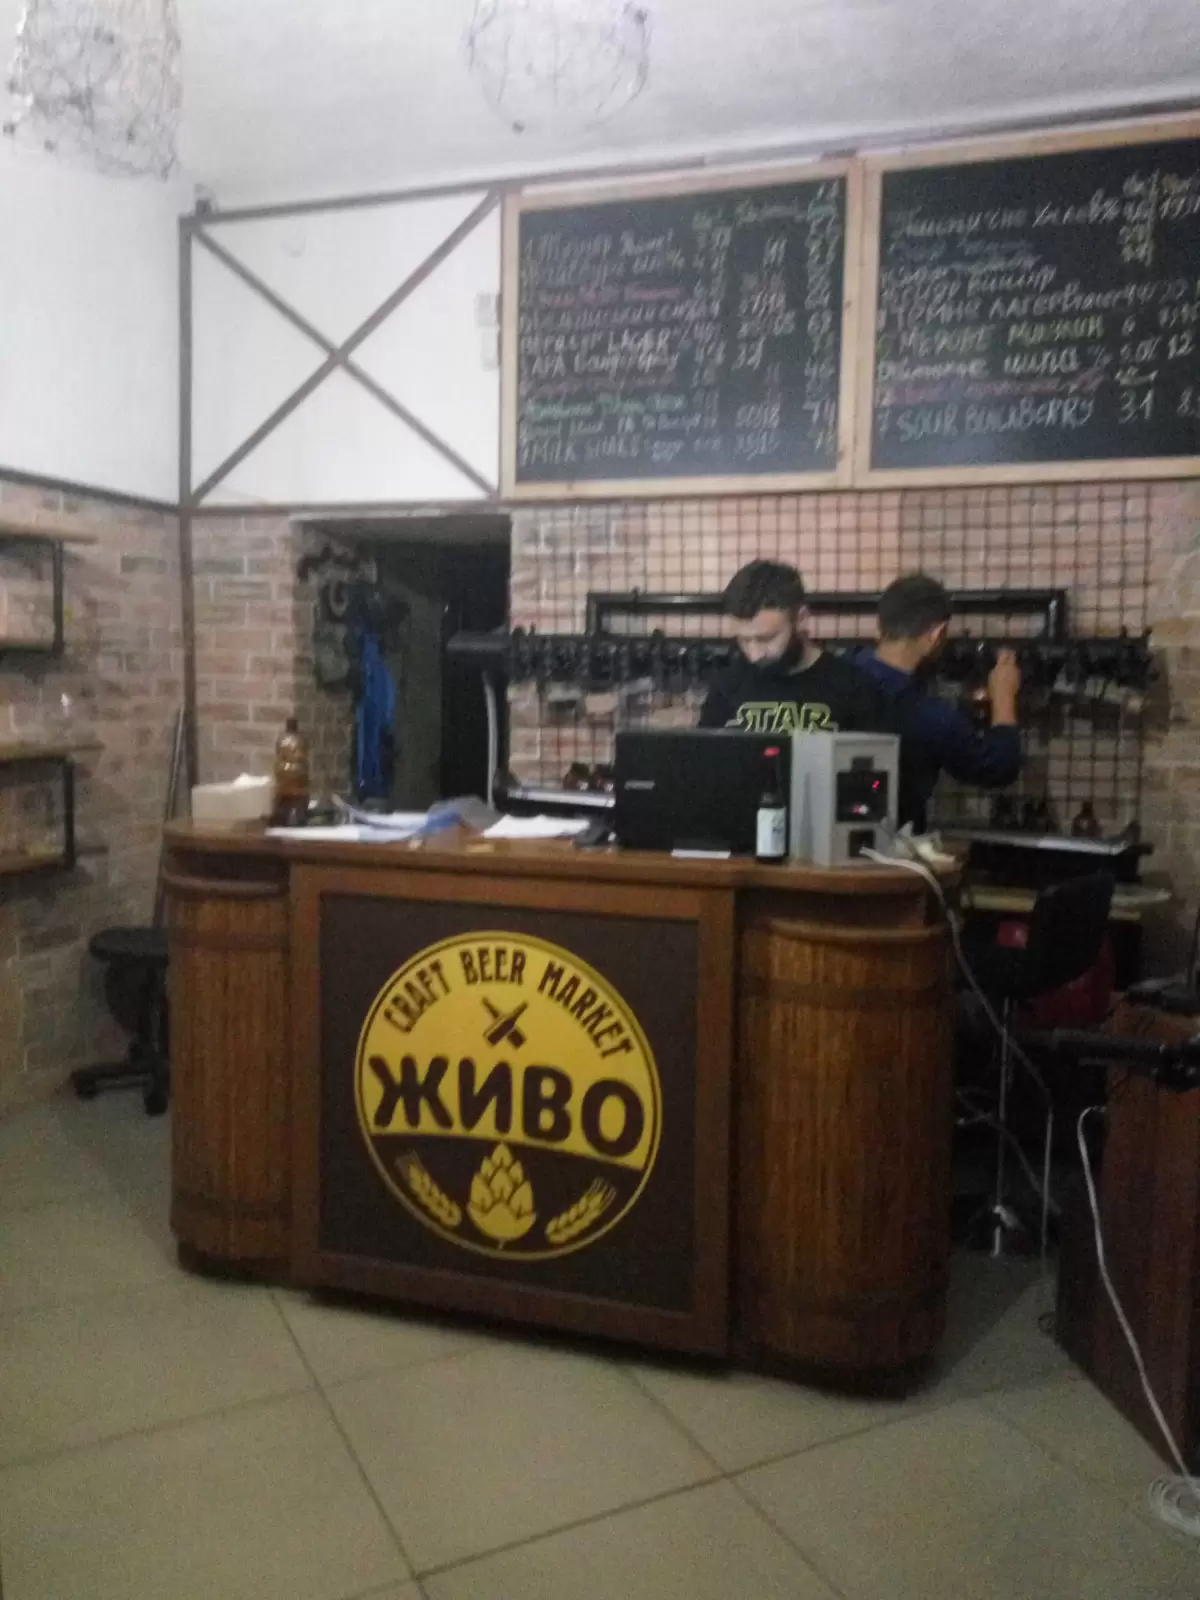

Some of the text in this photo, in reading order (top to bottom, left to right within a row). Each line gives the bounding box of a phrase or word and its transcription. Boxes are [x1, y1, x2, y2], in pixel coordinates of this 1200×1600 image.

[384, 946, 635, 1059] CRAFT BEER MARKET
[368, 1053, 644, 1157] ЖИВО
